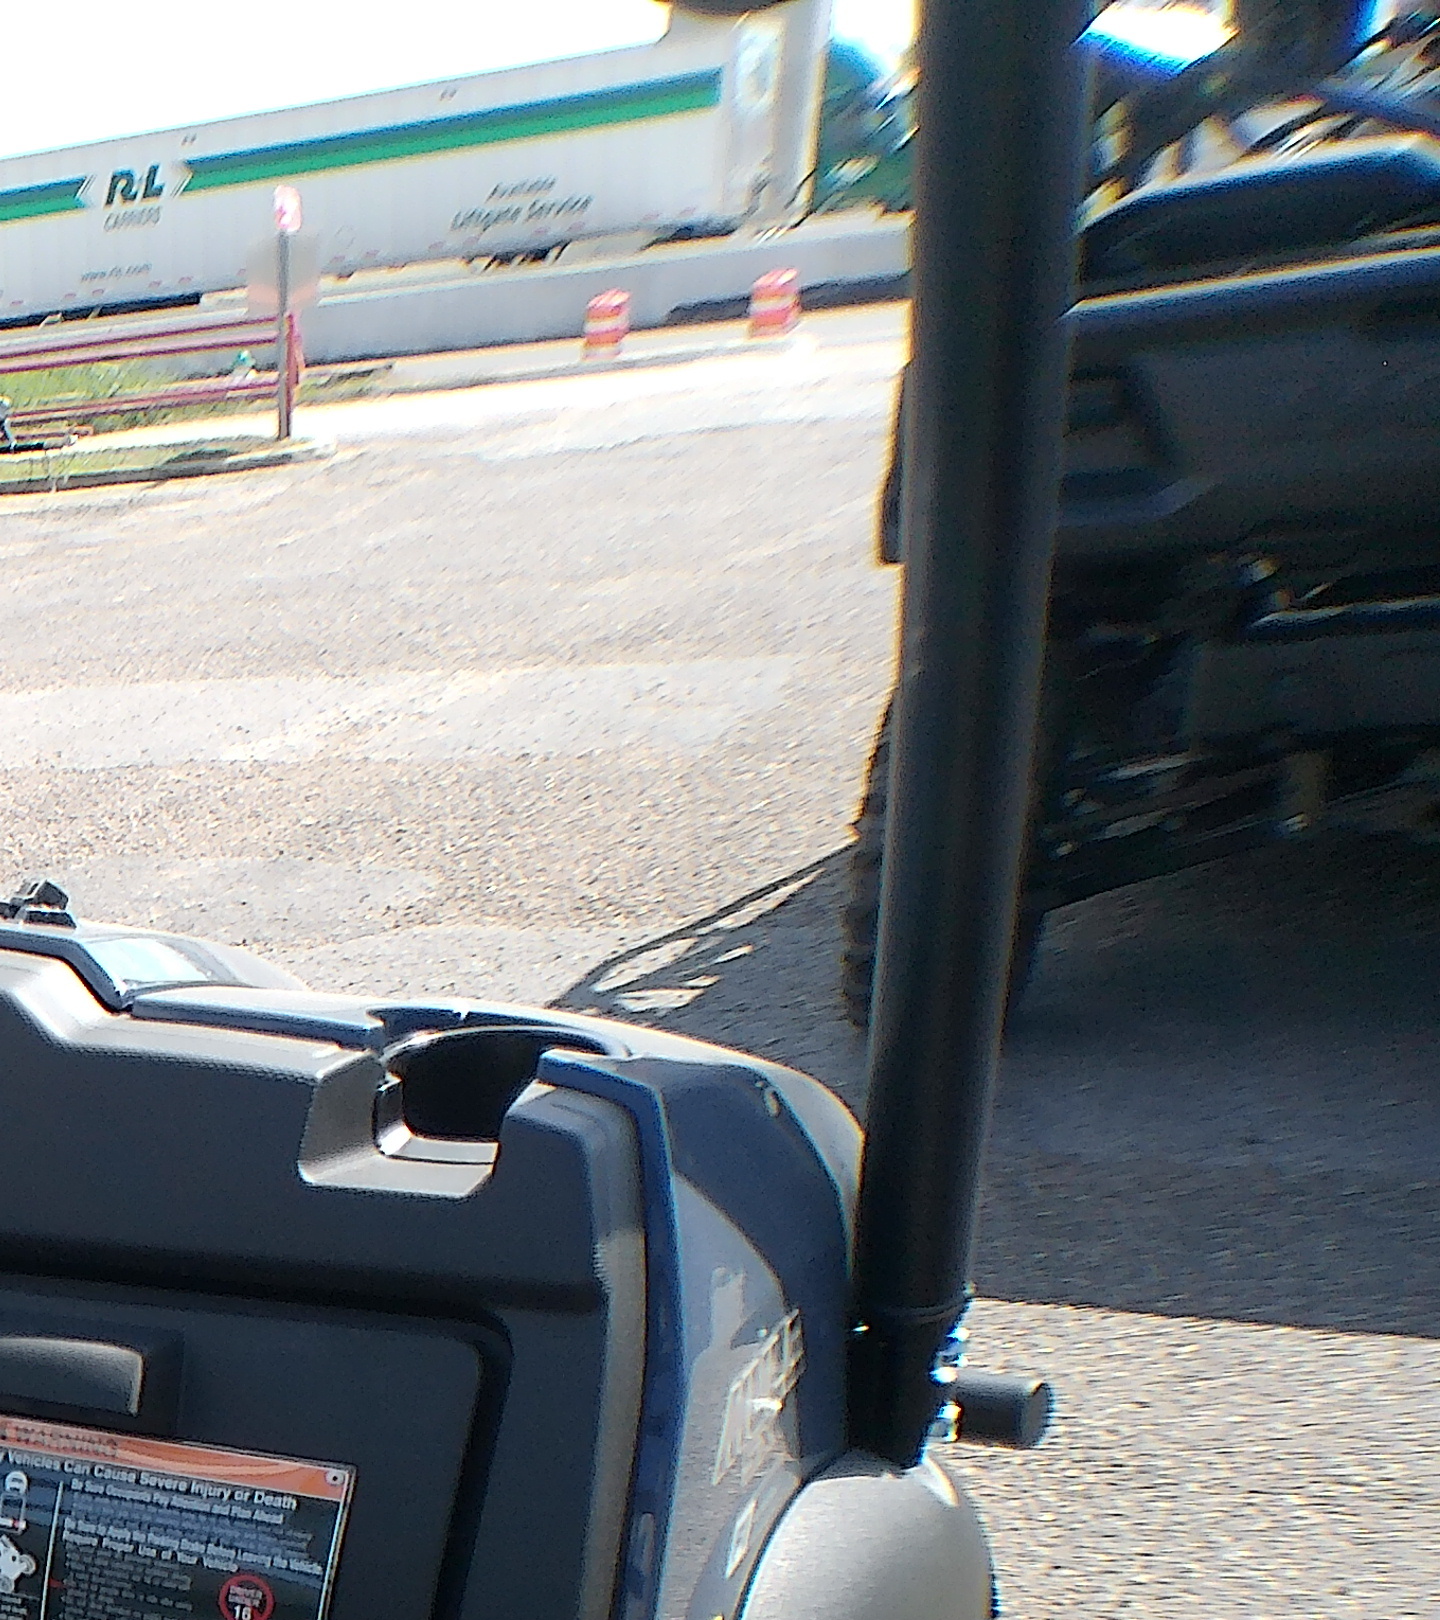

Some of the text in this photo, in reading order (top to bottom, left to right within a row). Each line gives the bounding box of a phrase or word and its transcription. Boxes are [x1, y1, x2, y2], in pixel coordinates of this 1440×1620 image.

[8, 1449, 61, 1473] Vehicles
[63, 1459, 91, 1477] Can
[93, 1464, 137, 1484] Cause
[139, 1471, 188, 1493] Severe
[191, 1480, 232, 1502] Injury
[234, 1489, 251, 1502] or
[254, 1491, 299, 1512] Death
